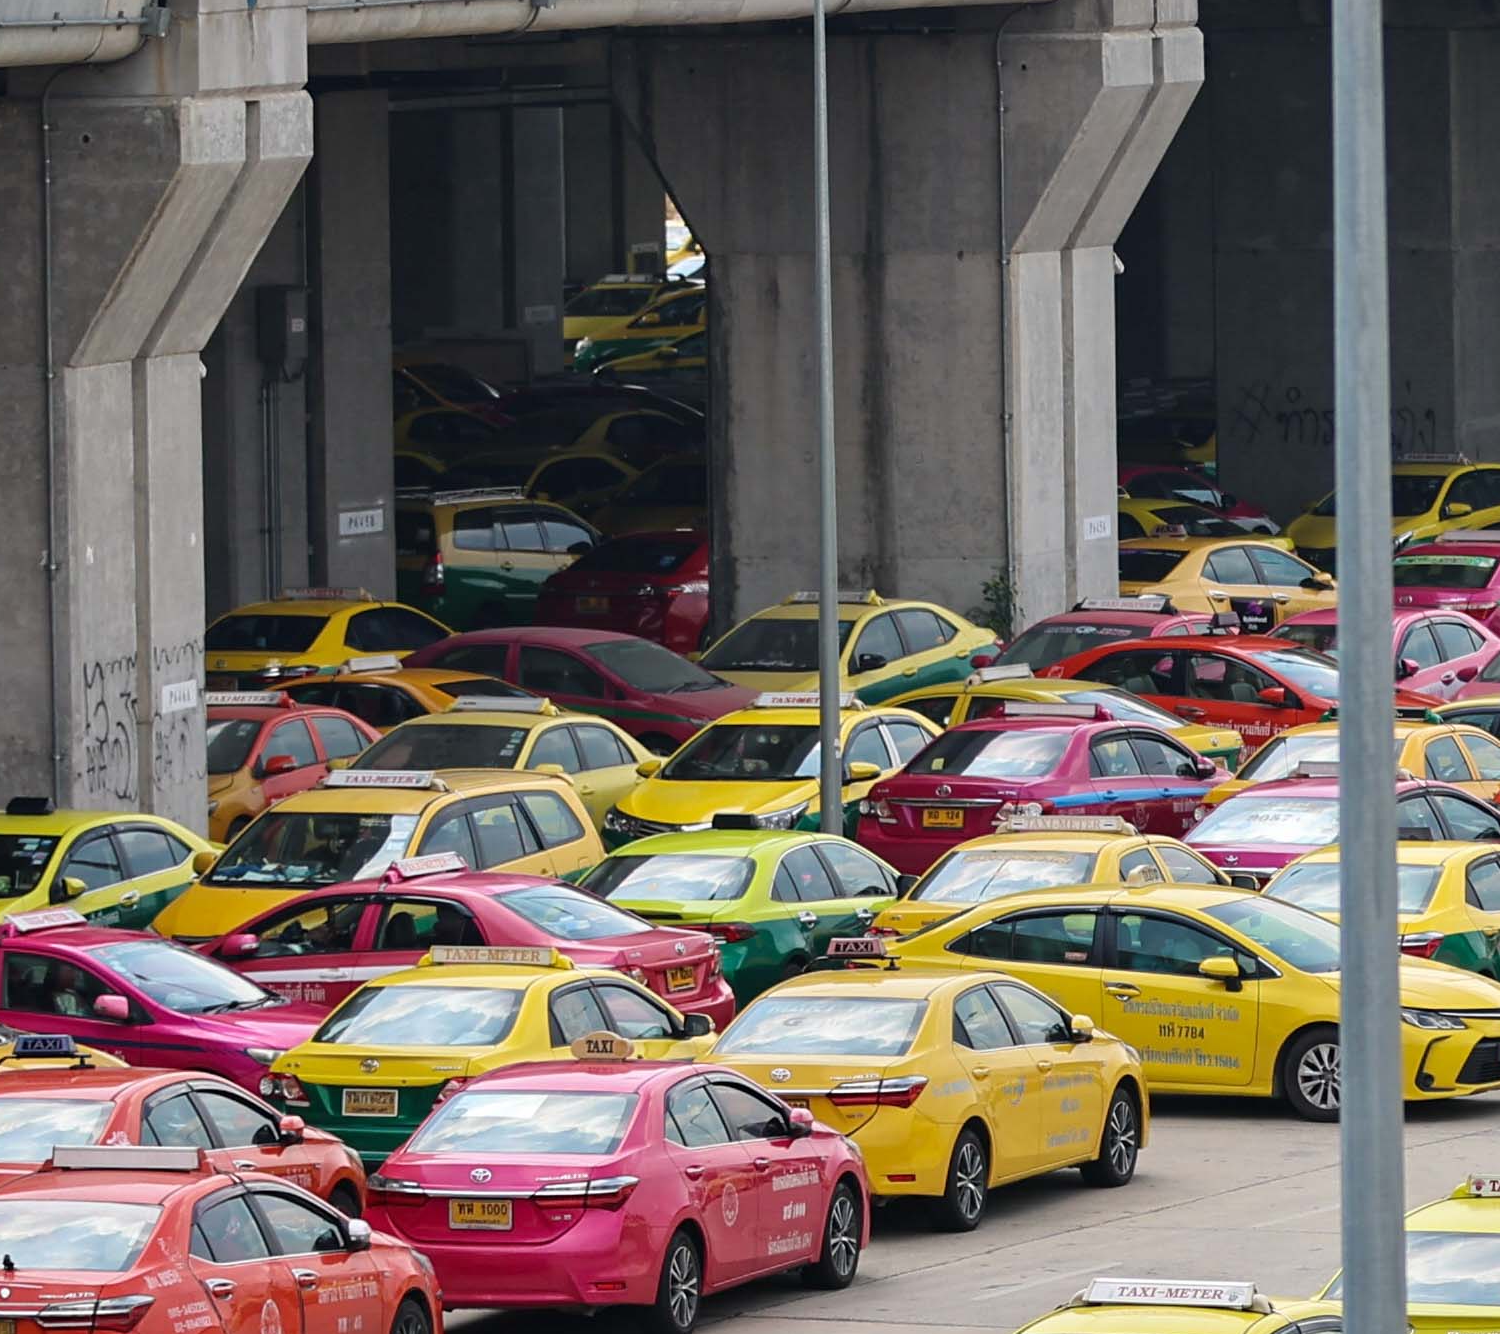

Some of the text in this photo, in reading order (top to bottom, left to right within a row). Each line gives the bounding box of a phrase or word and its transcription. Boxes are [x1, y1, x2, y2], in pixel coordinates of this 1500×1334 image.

[838, 941, 874, 952] TAXI
[442, 949, 542, 965] TAXI-METER
[25, 1038, 65, 1051] TAXI
[585, 1039, 615, 1054] TAXI
[482, 1203, 508, 1216] 1000
[1117, 1284, 1224, 1301] TAXI-METER
